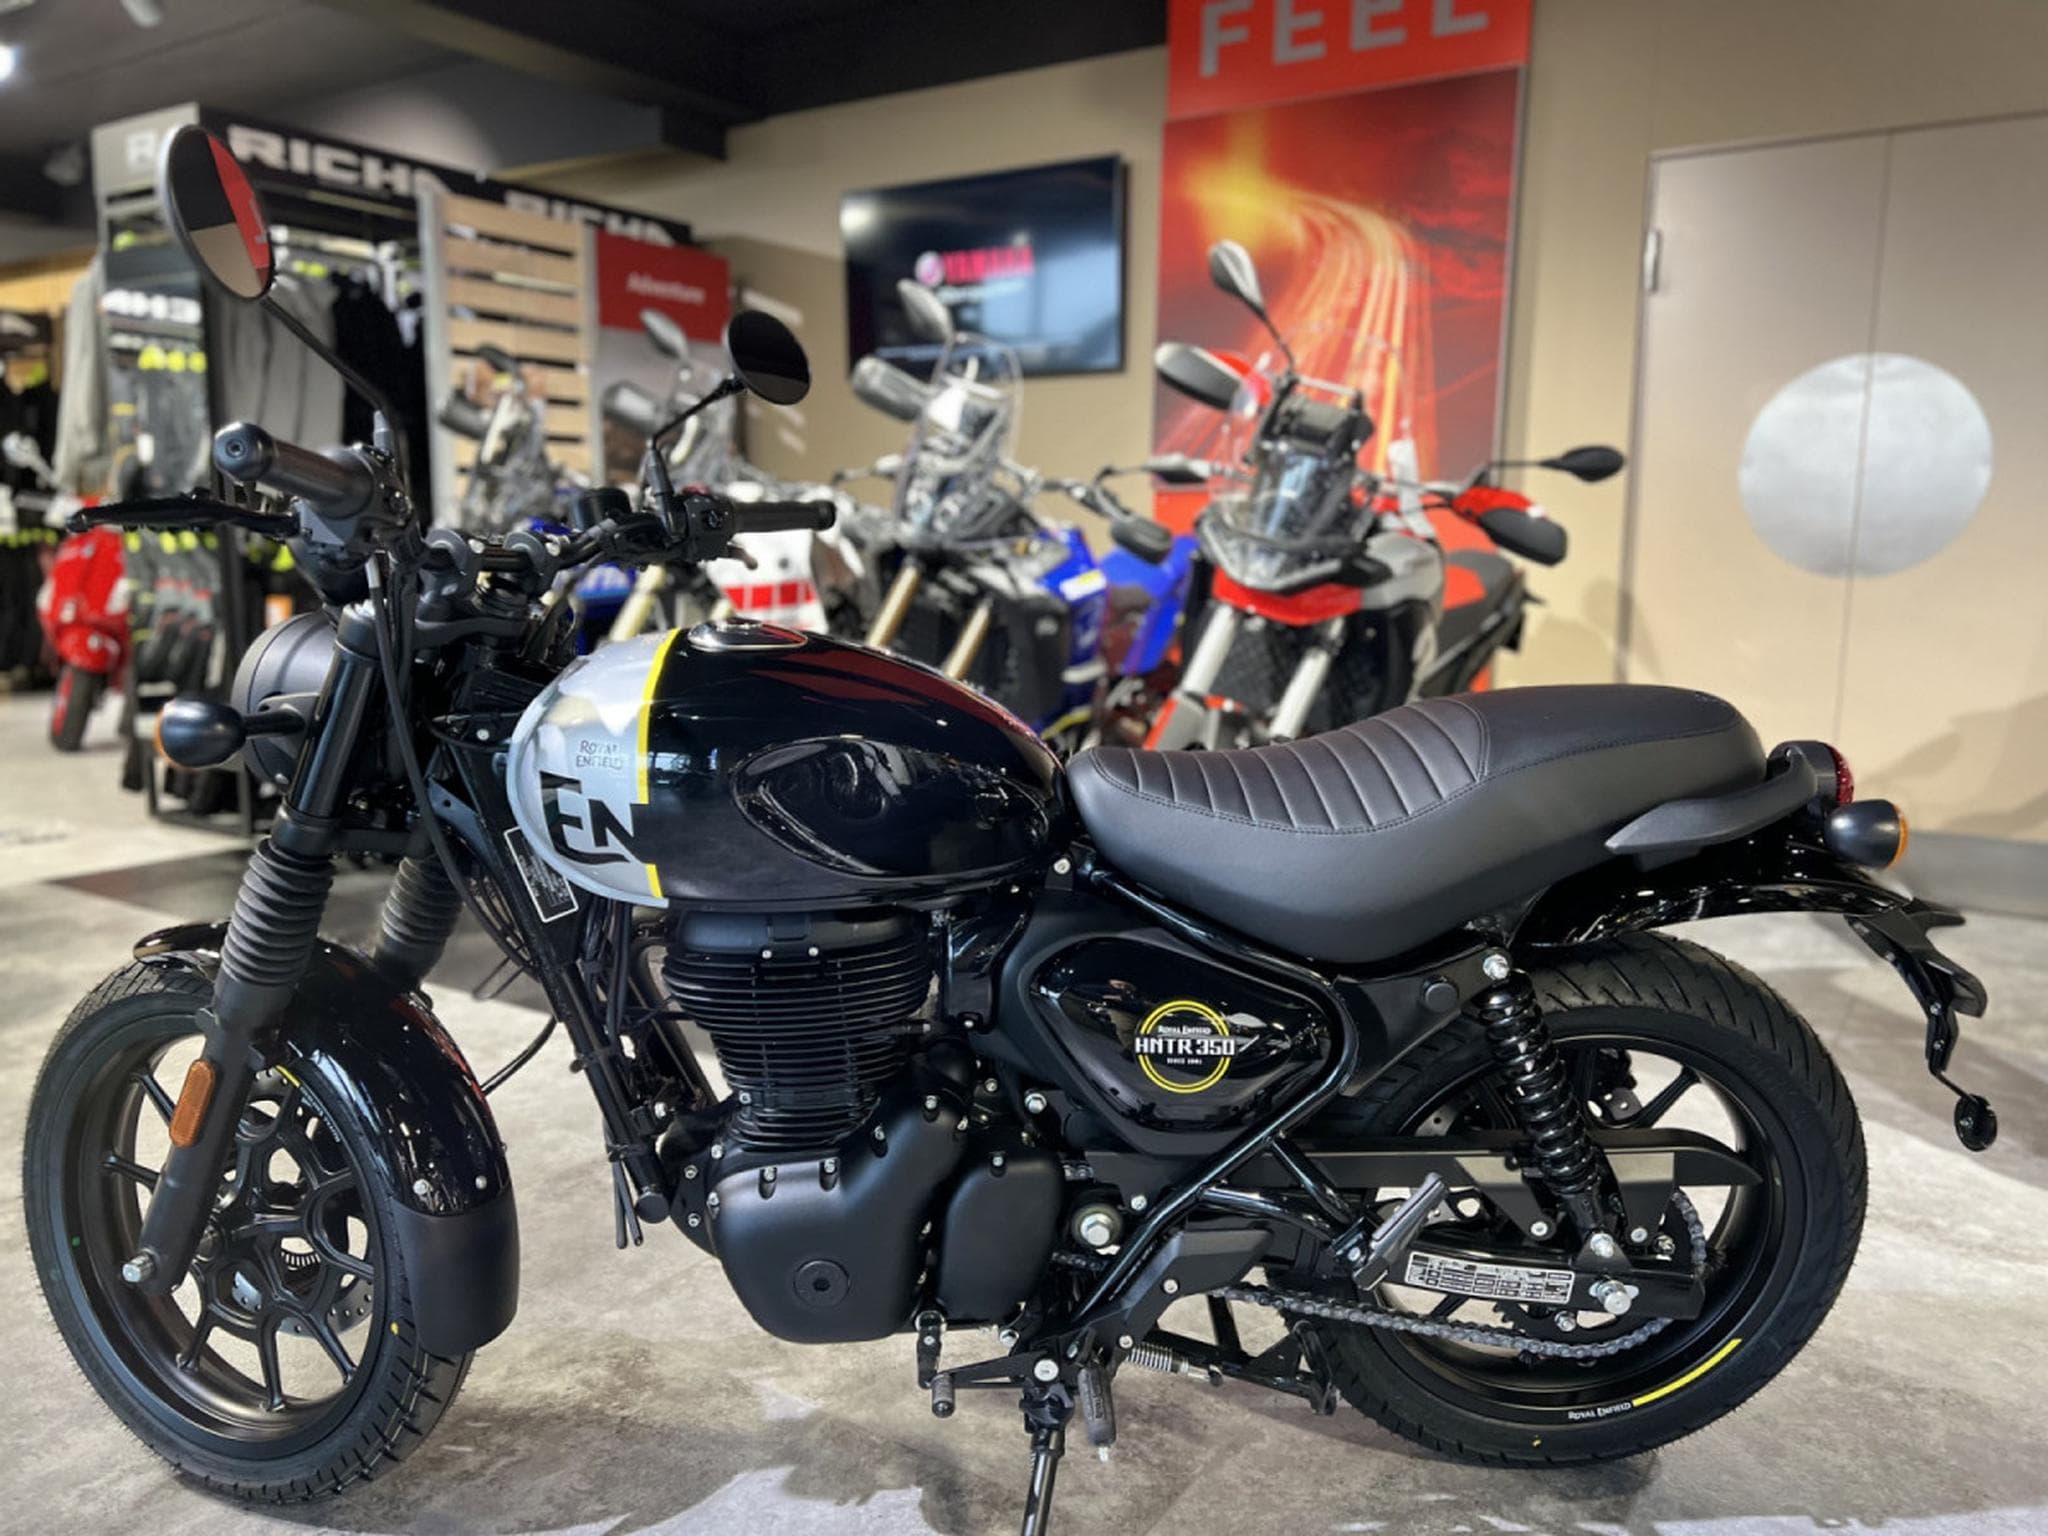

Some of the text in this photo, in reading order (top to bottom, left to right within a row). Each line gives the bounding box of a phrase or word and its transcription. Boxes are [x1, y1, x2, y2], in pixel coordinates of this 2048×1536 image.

[1200, 0, 1488, 78] FEEL
[1135, 1037, 1235, 1056] HNTR 350
